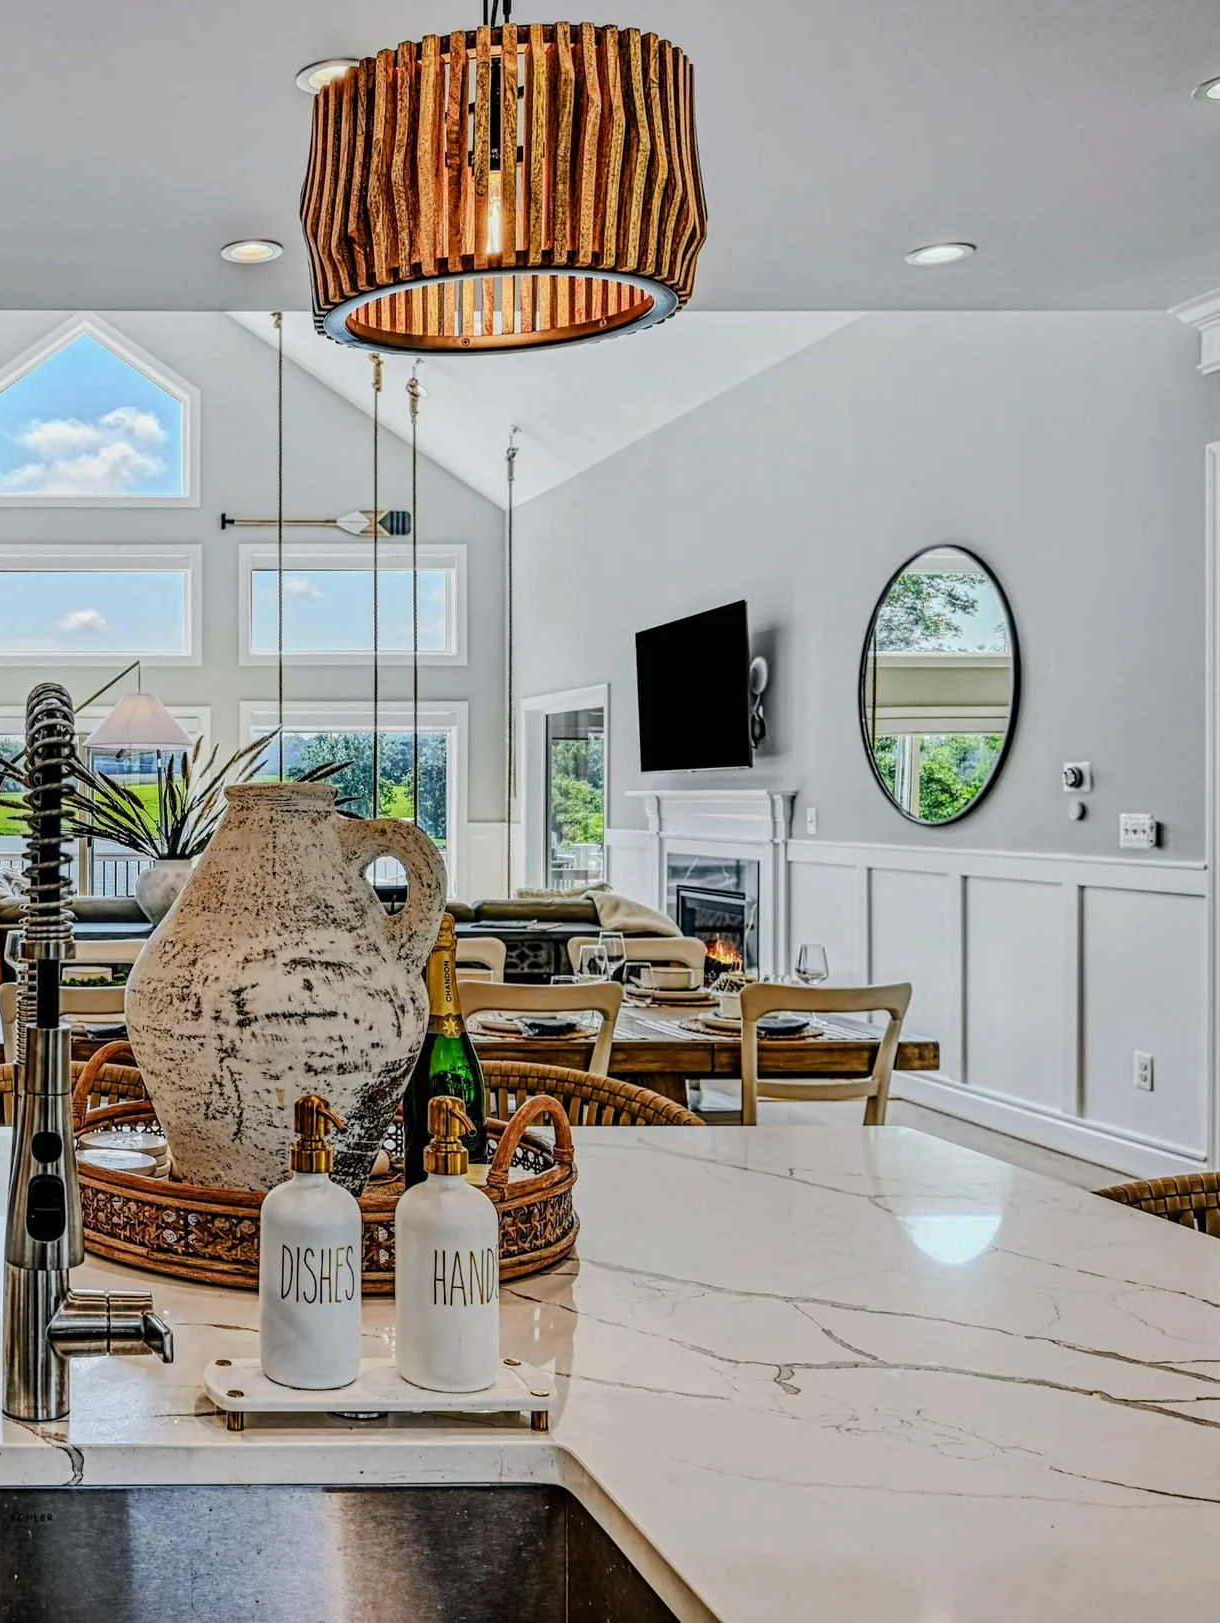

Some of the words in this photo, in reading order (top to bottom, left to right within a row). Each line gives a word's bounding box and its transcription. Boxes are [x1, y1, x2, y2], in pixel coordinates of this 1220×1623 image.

[443, 960, 453, 1003] CHANDON
[280, 1244, 355, 1304] DISHES
[10, 1513, 54, 1522] KOHLER
